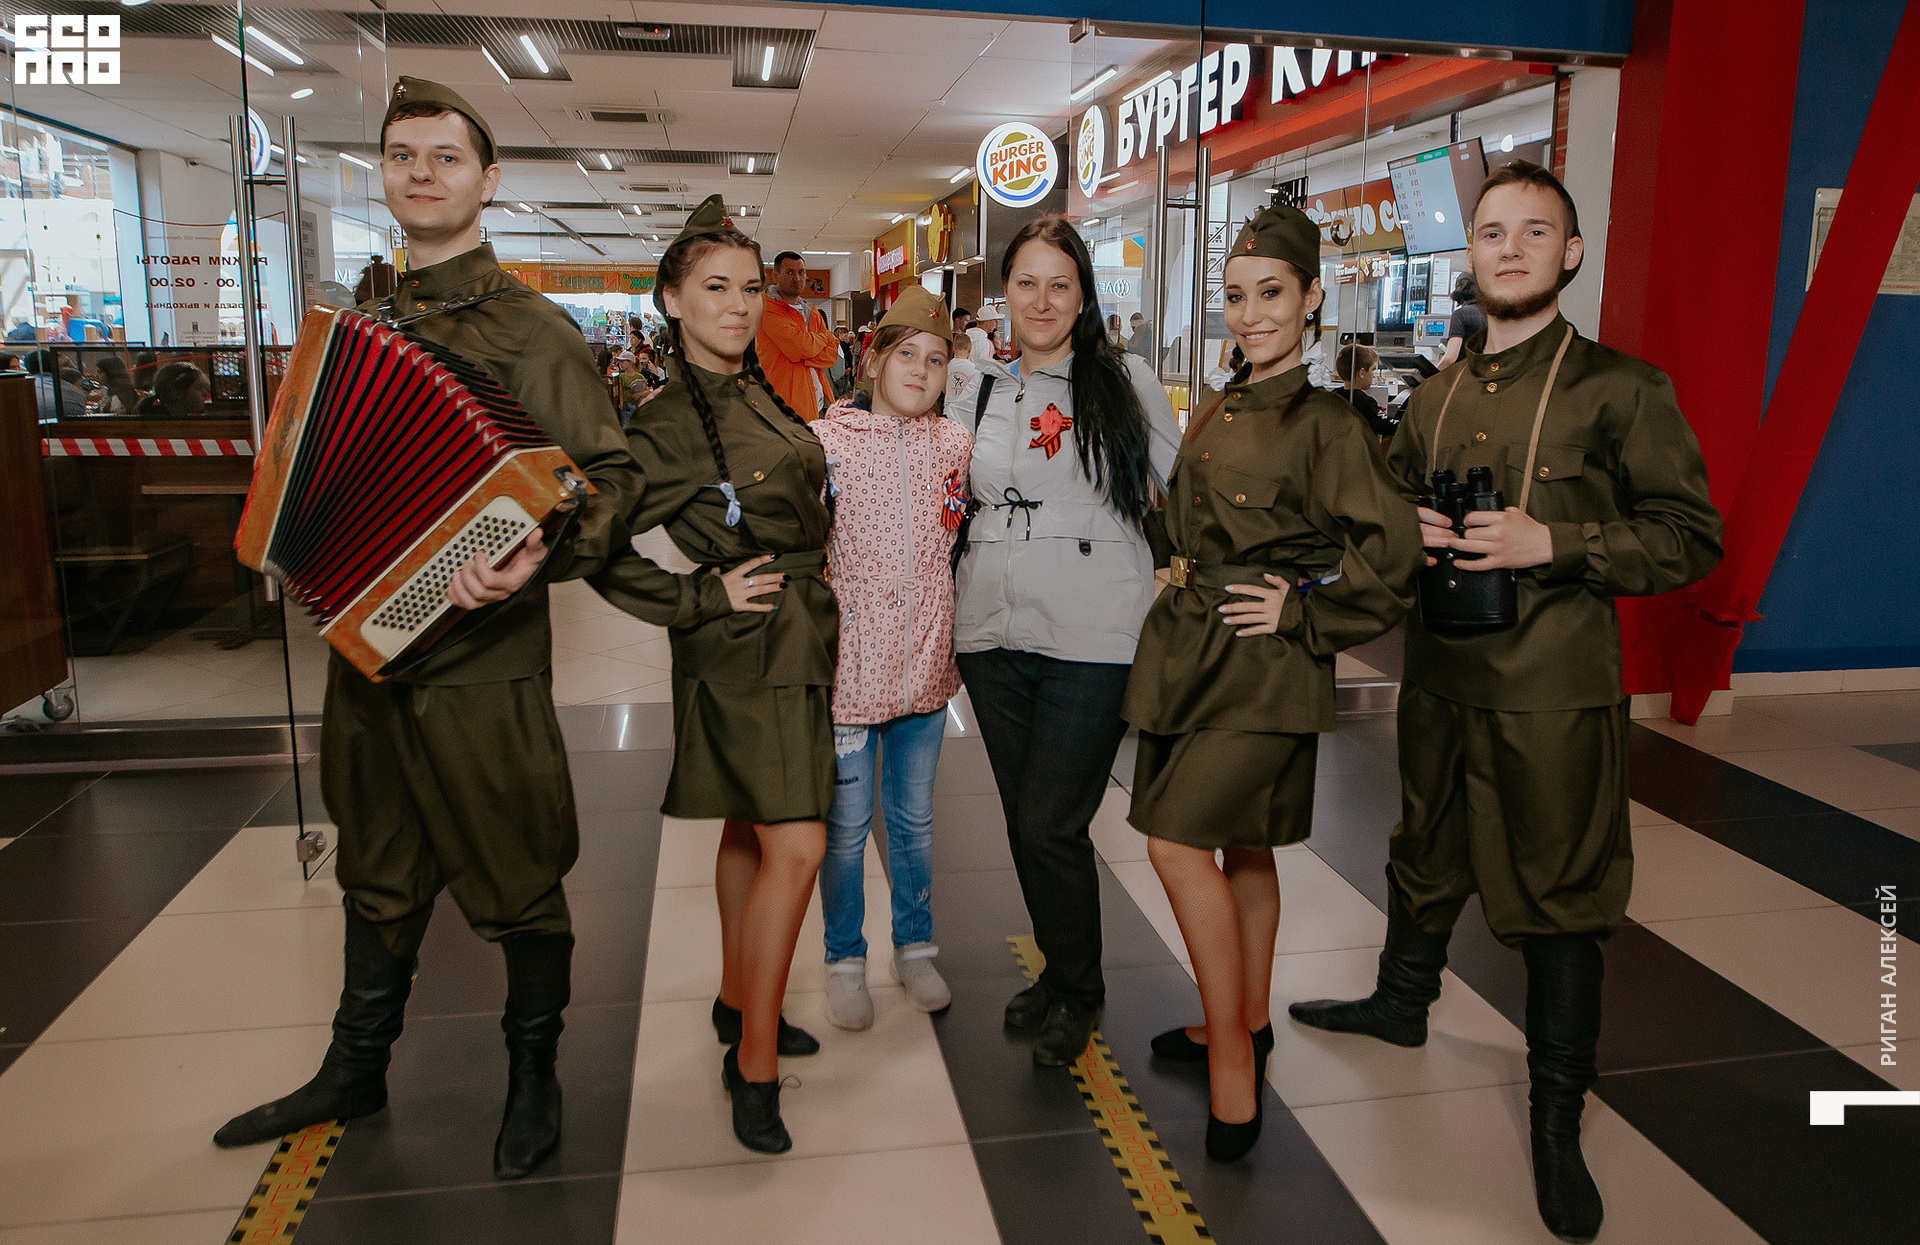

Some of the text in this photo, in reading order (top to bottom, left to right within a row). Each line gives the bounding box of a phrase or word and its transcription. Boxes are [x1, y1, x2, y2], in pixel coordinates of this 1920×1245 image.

[1117, 43, 1251, 168] БУРГЕР
[990, 141, 1044, 166] BURGER
[992, 154, 1047, 186] KING
[1106, 1106, 1179, 1218] СОБЛЮДАЙТЕ
